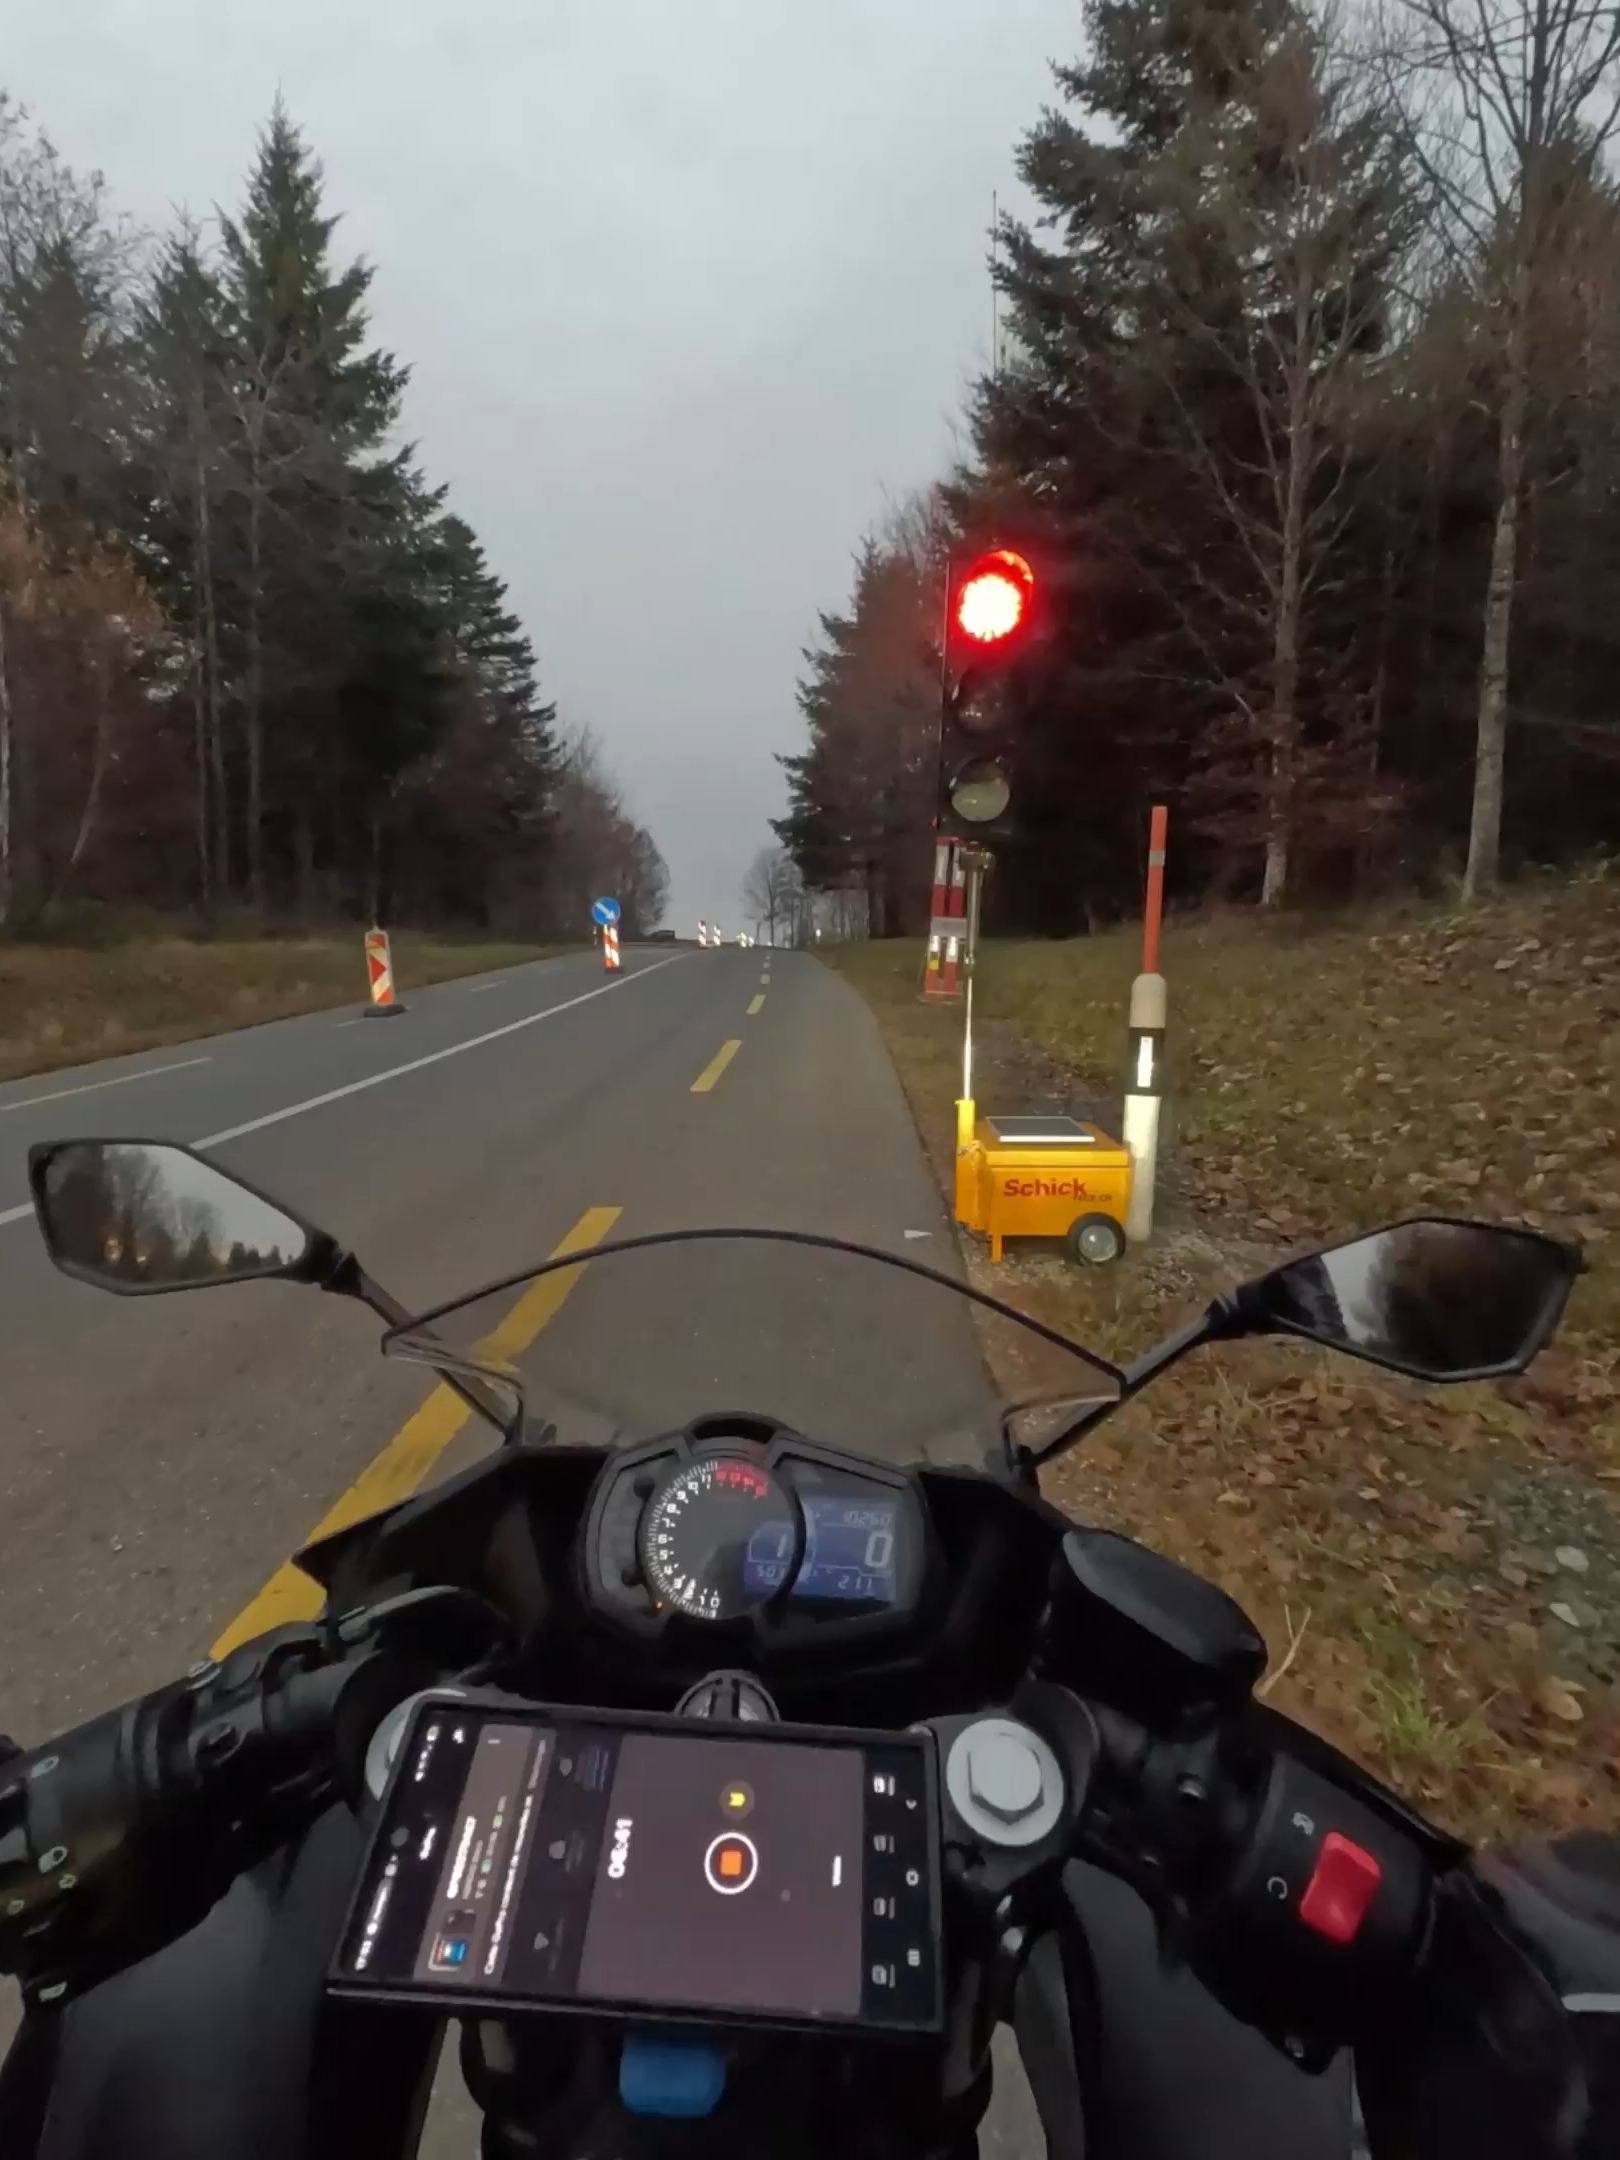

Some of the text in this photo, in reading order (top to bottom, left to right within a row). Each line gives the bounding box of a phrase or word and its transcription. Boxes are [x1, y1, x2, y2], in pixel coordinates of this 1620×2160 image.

[1003, 1178, 1086, 1197] Schick
[676, 1490, 687, 1501] 9
[666, 1503, 677, 1514] 8
[661, 1517, 671, 1529] 7
[657, 1533, 668, 1545] 6
[776, 1533, 788, 1559] 1
[864, 1530, 894, 1568] 0
[659, 1549, 669, 1561] 5
[663, 1565, 674, 1576] 4
[710, 1597, 720, 1608] 0
